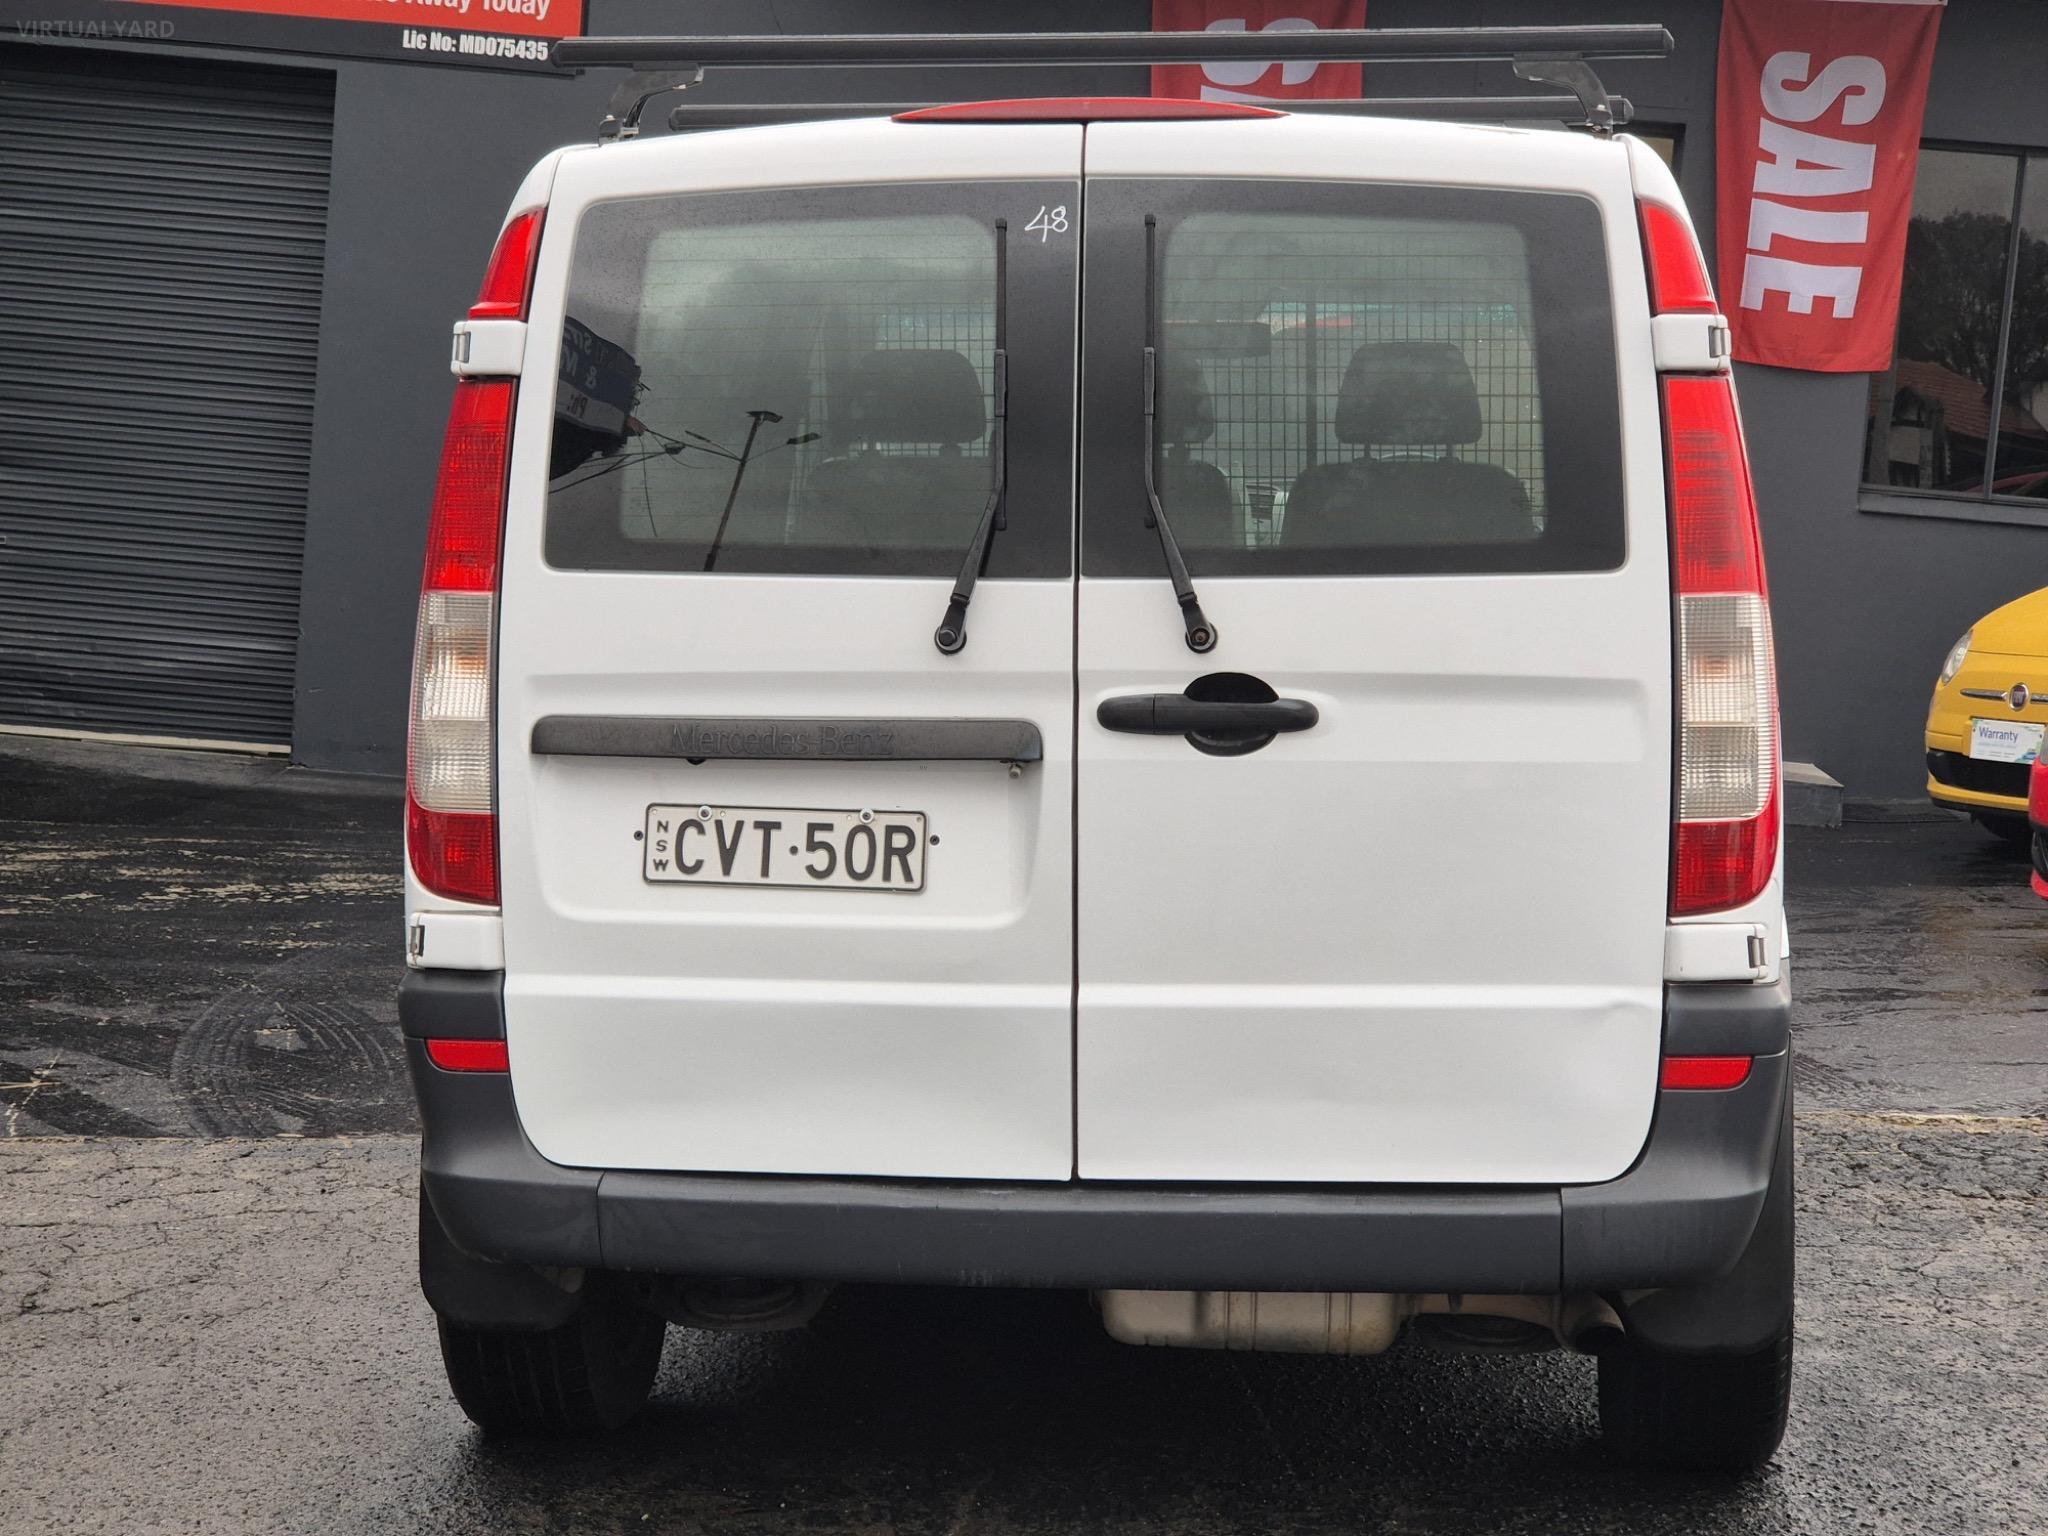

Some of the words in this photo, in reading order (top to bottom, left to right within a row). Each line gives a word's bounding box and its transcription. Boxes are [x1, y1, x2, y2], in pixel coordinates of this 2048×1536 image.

[402, 29, 426, 49] Lic
[430, 32, 456, 52] No:
[459, 34, 549, 61] MD075435
[1739, 51, 1887, 319] SALE
[1024, 205, 1068, 243] 48
[1979, 726, 2019, 743] Warranty
